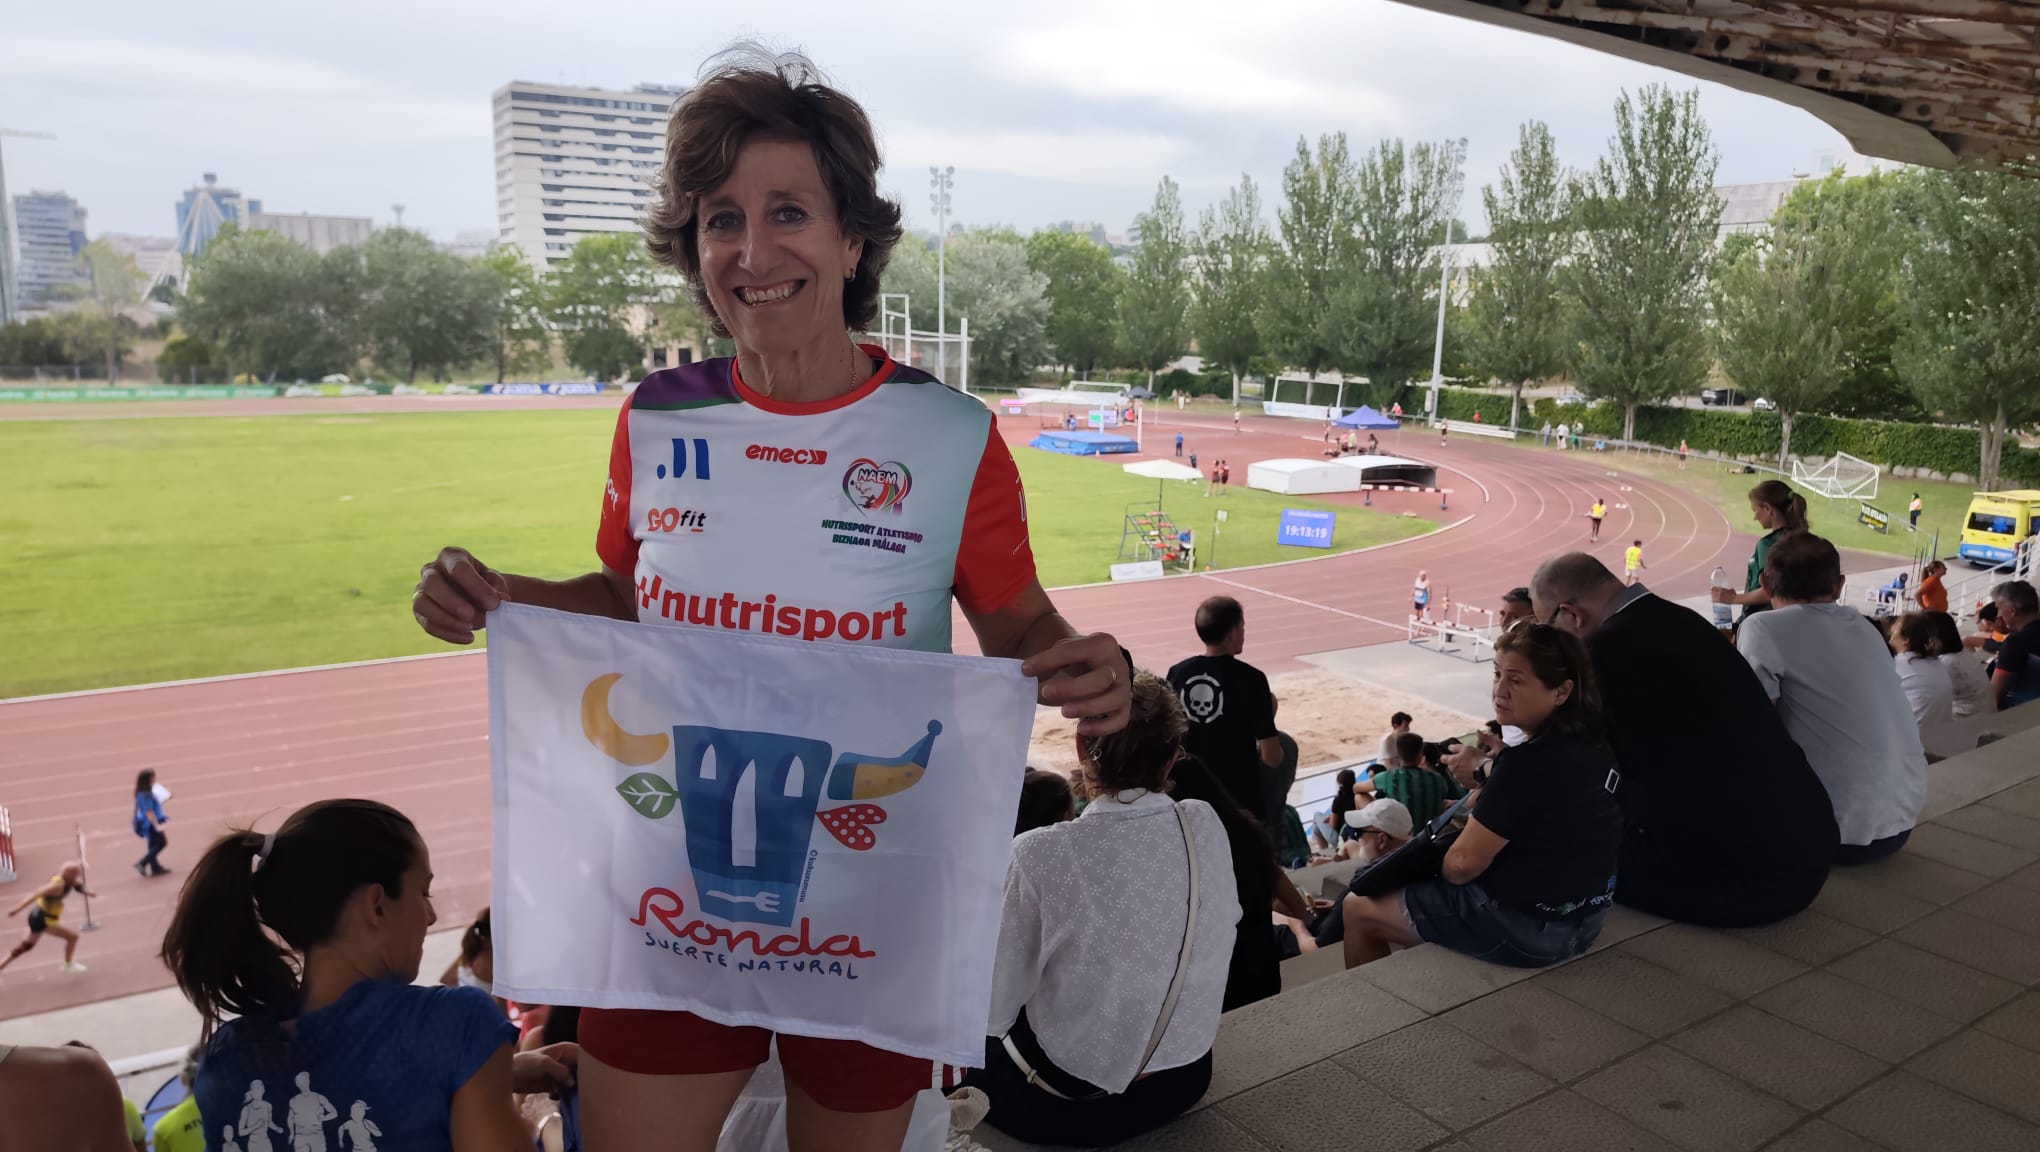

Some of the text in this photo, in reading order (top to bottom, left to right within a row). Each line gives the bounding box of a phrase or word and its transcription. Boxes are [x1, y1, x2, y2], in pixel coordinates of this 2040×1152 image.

[745, 444, 808, 464] emec
[821, 519, 923, 543] NUTRISPORT ATLETISMO
[661, 589, 907, 641] nutrisport
[630, 887, 876, 958] Ronda
[645, 931, 859, 980] SUERTE NATURAL
